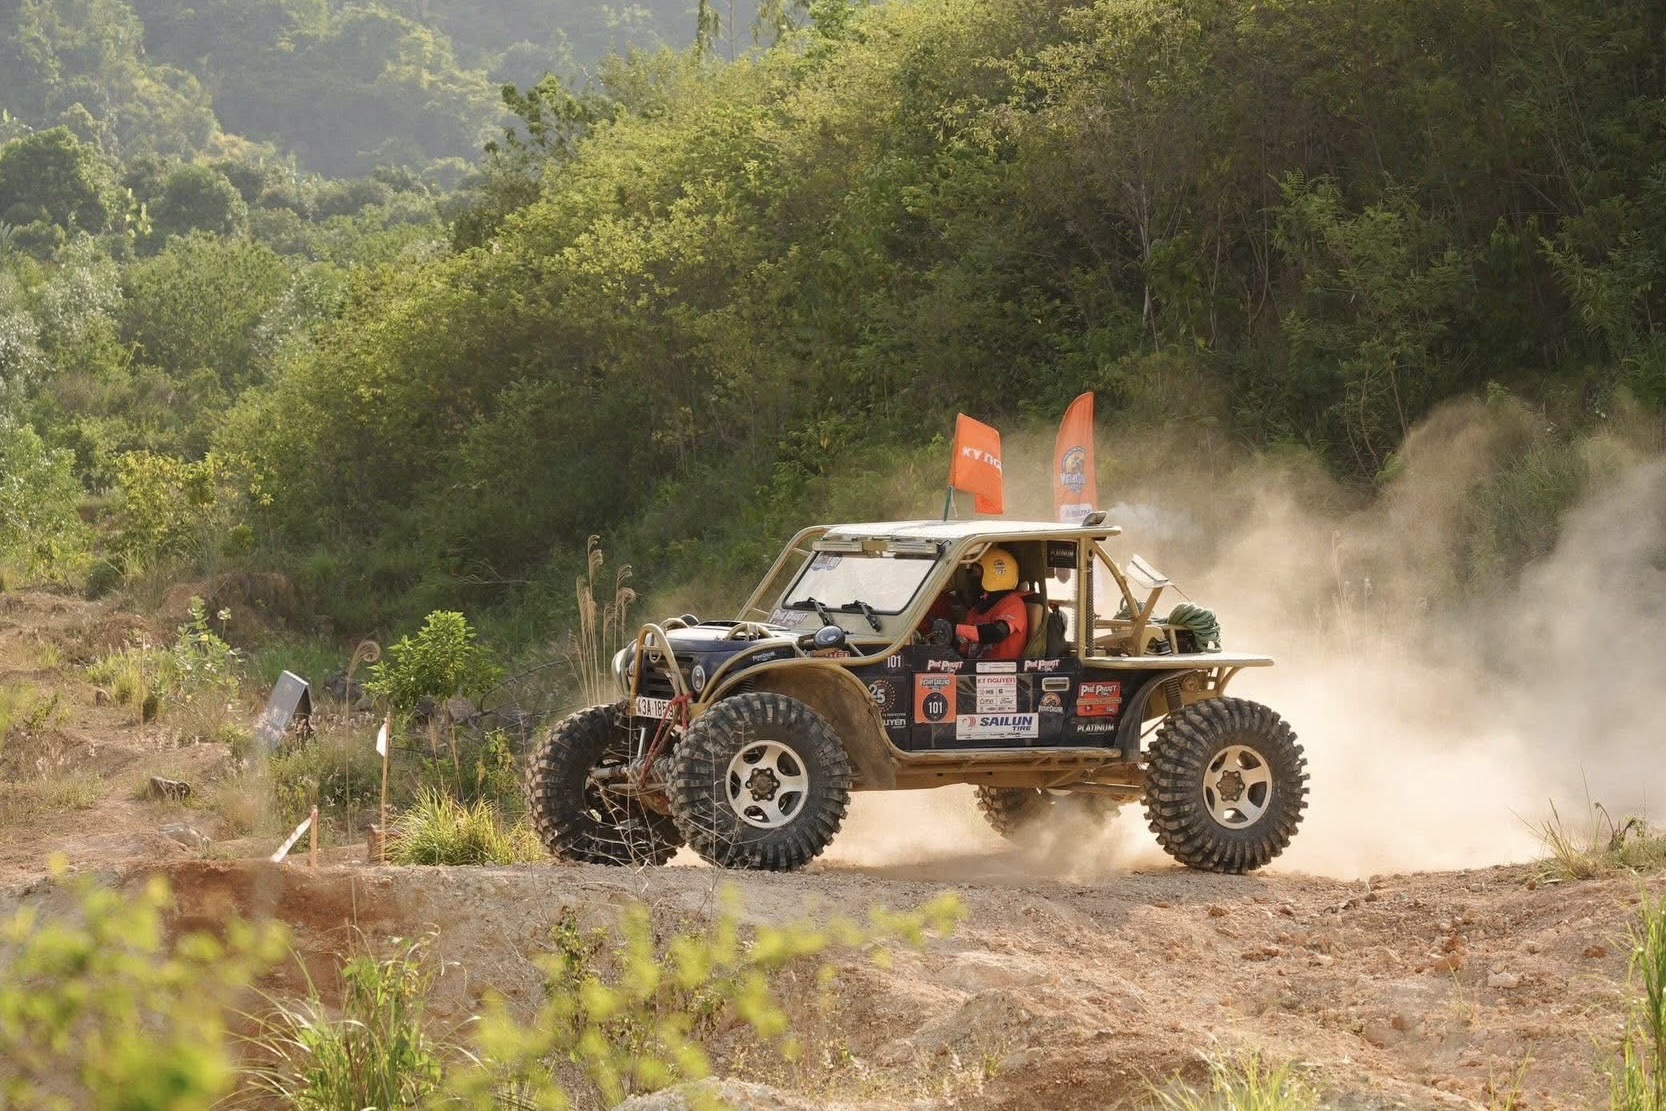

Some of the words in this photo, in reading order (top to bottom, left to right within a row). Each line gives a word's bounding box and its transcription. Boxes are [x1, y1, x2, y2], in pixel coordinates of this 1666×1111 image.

[887, 655, 901, 668] 101
[868, 683, 886, 703] 25
[928, 701, 943, 714] 101
[980, 716, 1033, 726] SAILUN
[1077, 723, 1114, 732] PLATINUM
